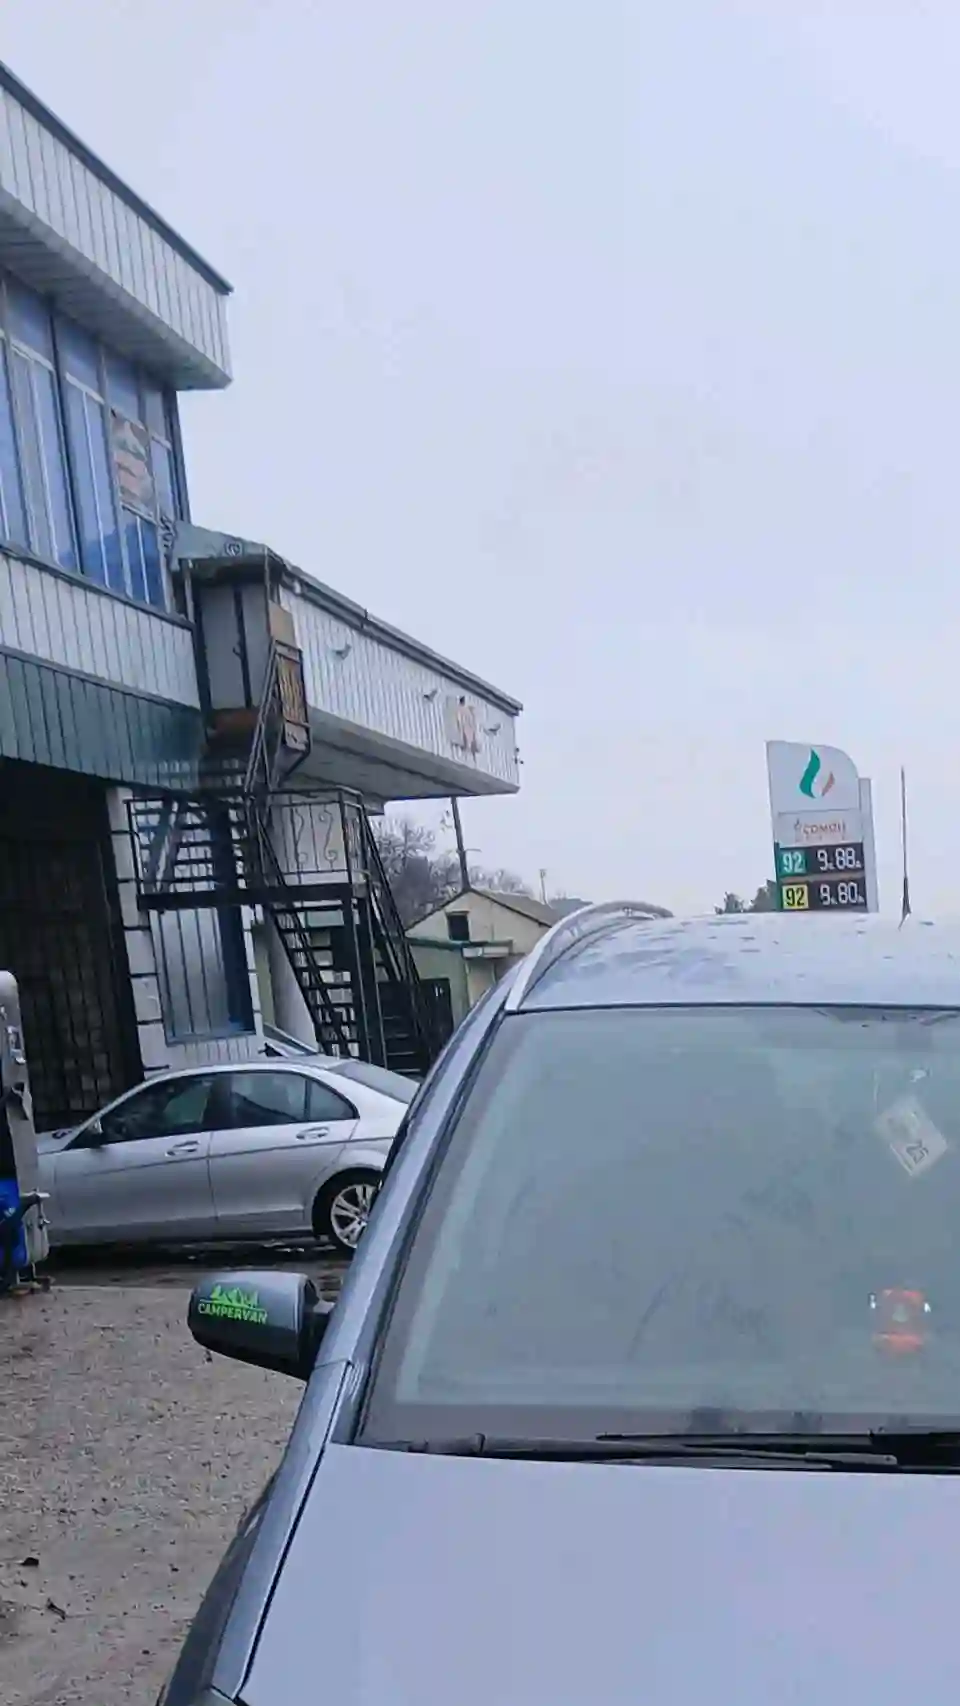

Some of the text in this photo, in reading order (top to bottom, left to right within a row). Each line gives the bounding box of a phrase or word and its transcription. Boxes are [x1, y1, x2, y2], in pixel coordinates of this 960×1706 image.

[782, 851, 804, 873] 92
[786, 887, 805, 906] 92
[198, 1303, 267, 1324] CAMPERVAN
